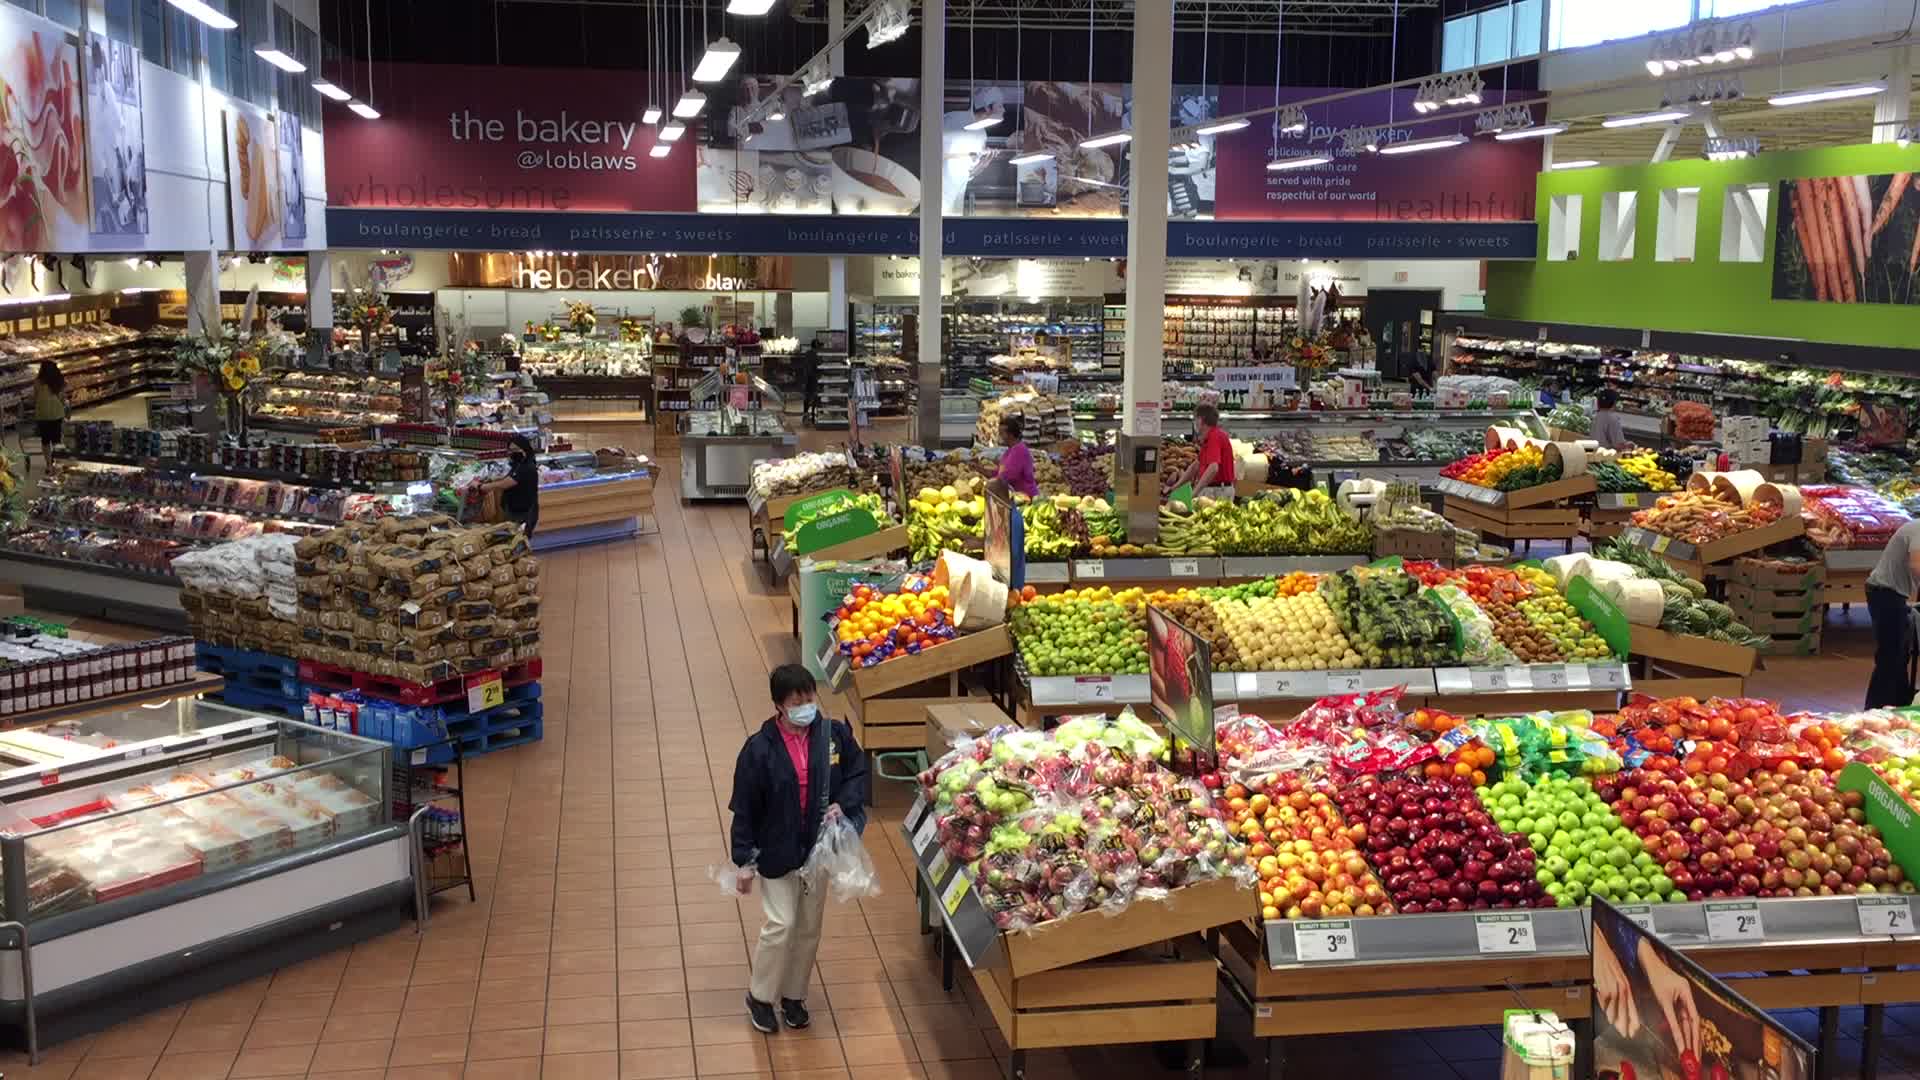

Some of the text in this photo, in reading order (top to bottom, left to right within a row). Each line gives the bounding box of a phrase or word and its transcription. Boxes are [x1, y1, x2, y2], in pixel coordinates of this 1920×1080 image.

[450, 110, 637, 150] the bakery
[1308, 121, 1337, 143] joy
[517, 150, 637, 170] @loblaws
[1336, 163, 1358, 171] care
[1267, 176, 1351, 187] served with pride
[337, 172, 570, 209] wholesome
[1266, 190, 1376, 200] respectful of our world
[1376, 191, 1536, 220] healthful
[359, 223, 733, 241] boulangerie bread patisserie sweets
[787, 228, 889, 245] boulangerie
[983, 231, 1126, 246] patisserie sweet
[1185, 232, 1510, 249] boulangerie bread patisserie sweets
[895, 269, 921, 279] baker
[1868, 780, 1912, 829] ORGANIC
